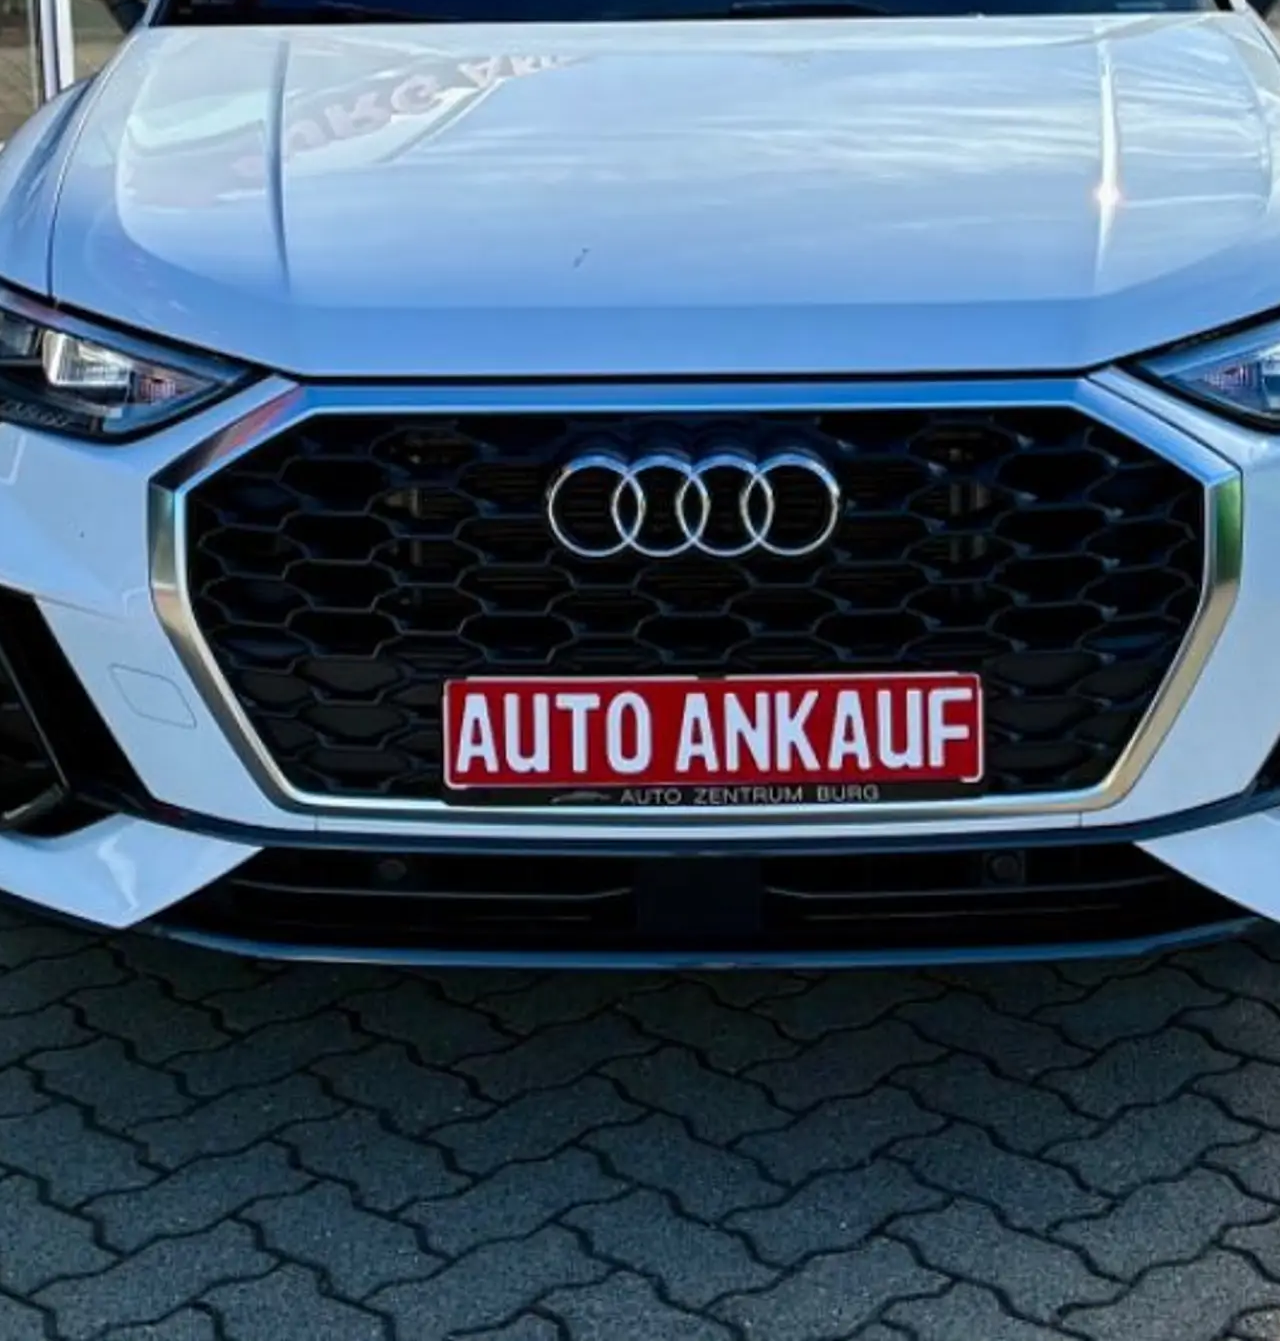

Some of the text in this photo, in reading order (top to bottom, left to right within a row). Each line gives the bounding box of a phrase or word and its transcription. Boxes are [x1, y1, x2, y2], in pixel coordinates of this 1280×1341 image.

[456, 687, 974, 774] AUTO ANKAUF
[620, 784, 880, 805] AUTO ZENTRUM BURG
